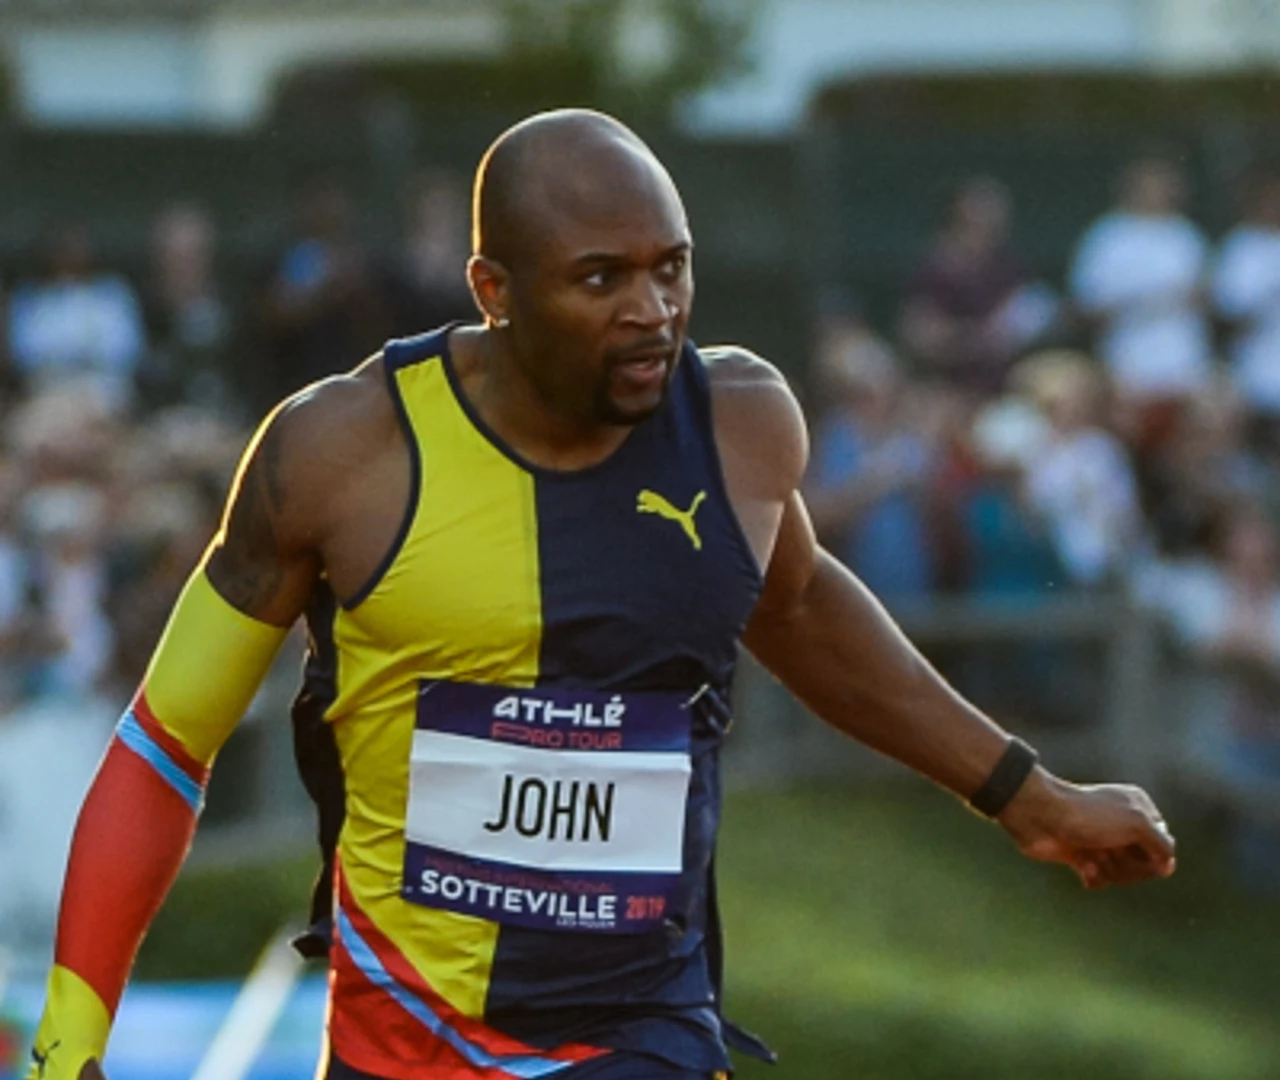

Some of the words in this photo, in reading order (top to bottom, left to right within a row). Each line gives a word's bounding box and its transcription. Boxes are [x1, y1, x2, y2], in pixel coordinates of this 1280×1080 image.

[493, 694, 625, 727] ATHLÉ
[490, 721, 564, 749] PRO
[567, 731, 622, 750] TOUR
[483, 774, 616, 843] JOHN
[421, 869, 617, 920] SOTTEVILLE
[625, 896, 667, 920] 2019
